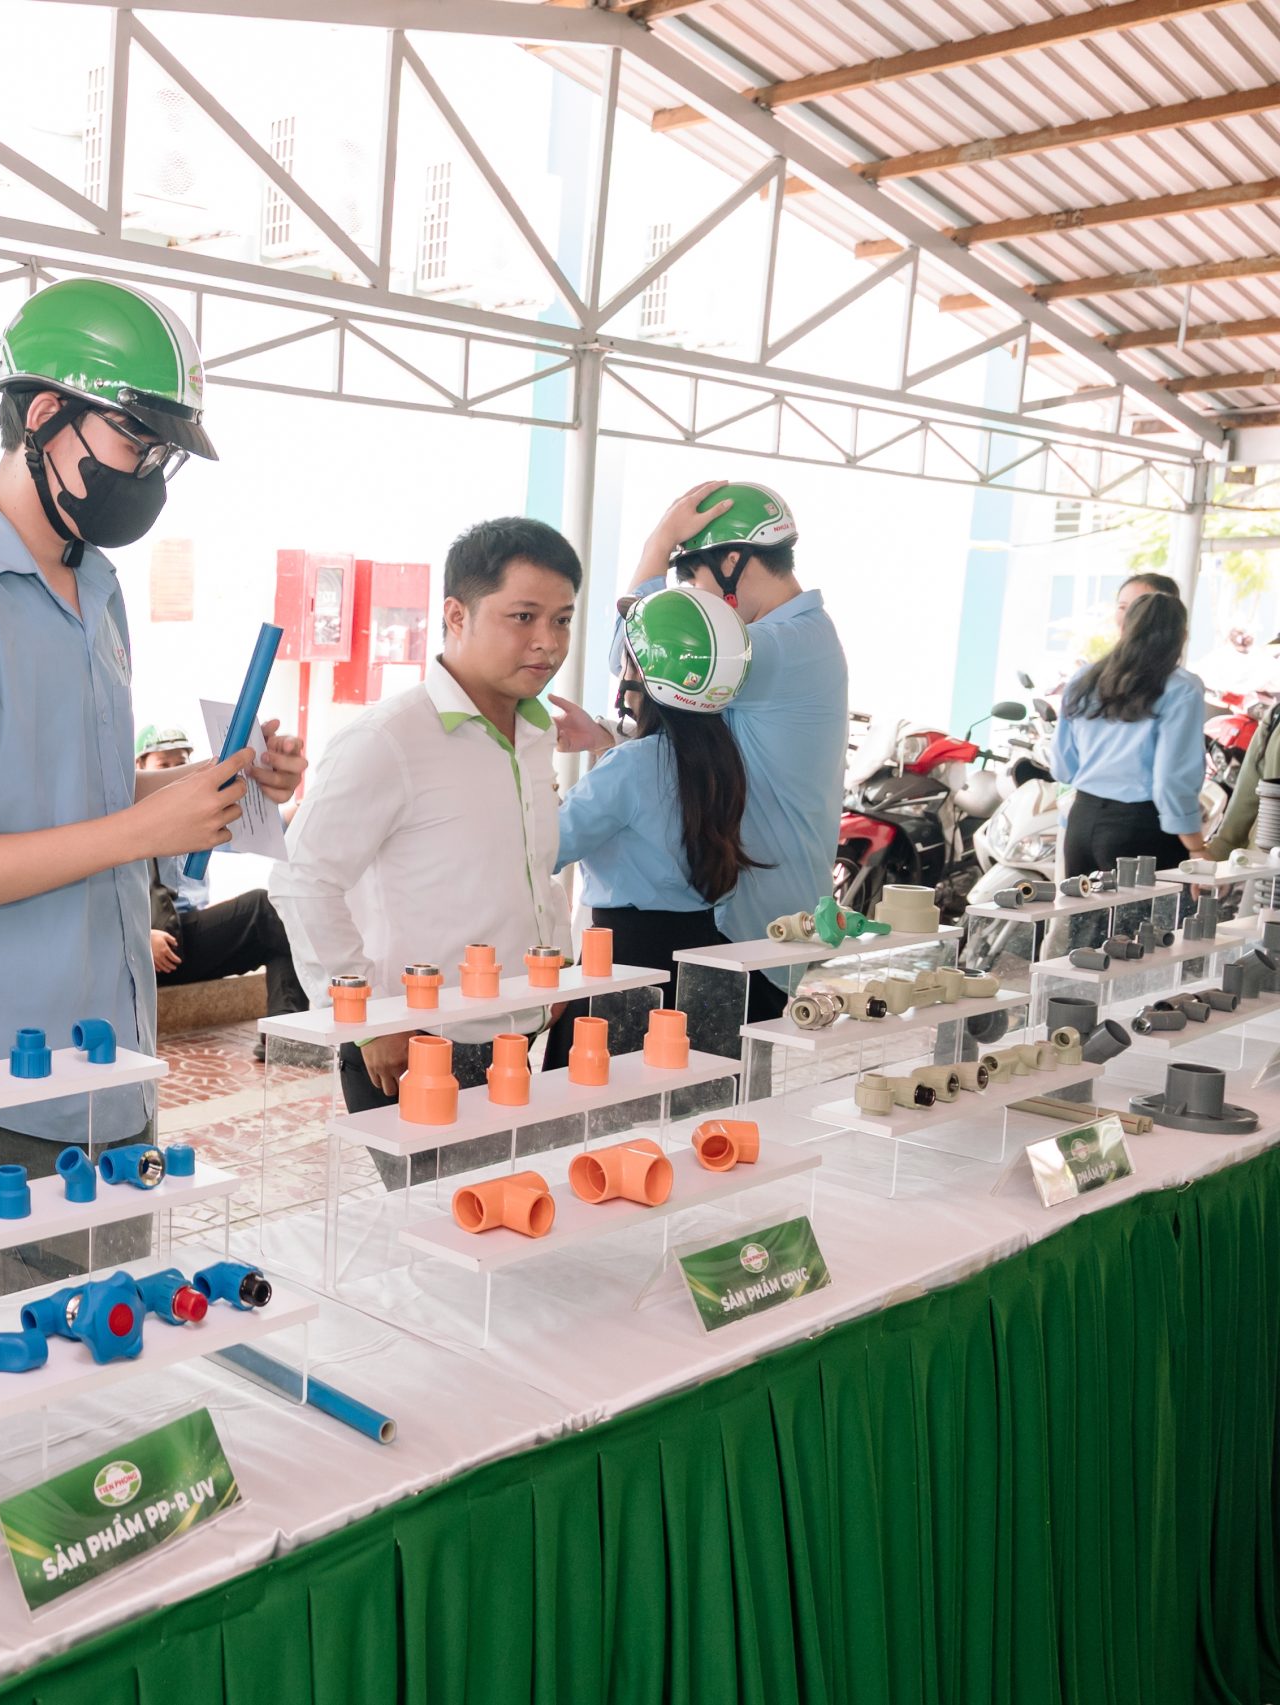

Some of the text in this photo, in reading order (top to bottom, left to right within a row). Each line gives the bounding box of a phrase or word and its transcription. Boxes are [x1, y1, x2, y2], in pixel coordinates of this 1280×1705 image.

[721, 1267, 810, 1312] SẢN PHẨM CPVC
[42, 1476, 216, 1581] SẢN PHẨM PP-R UV
